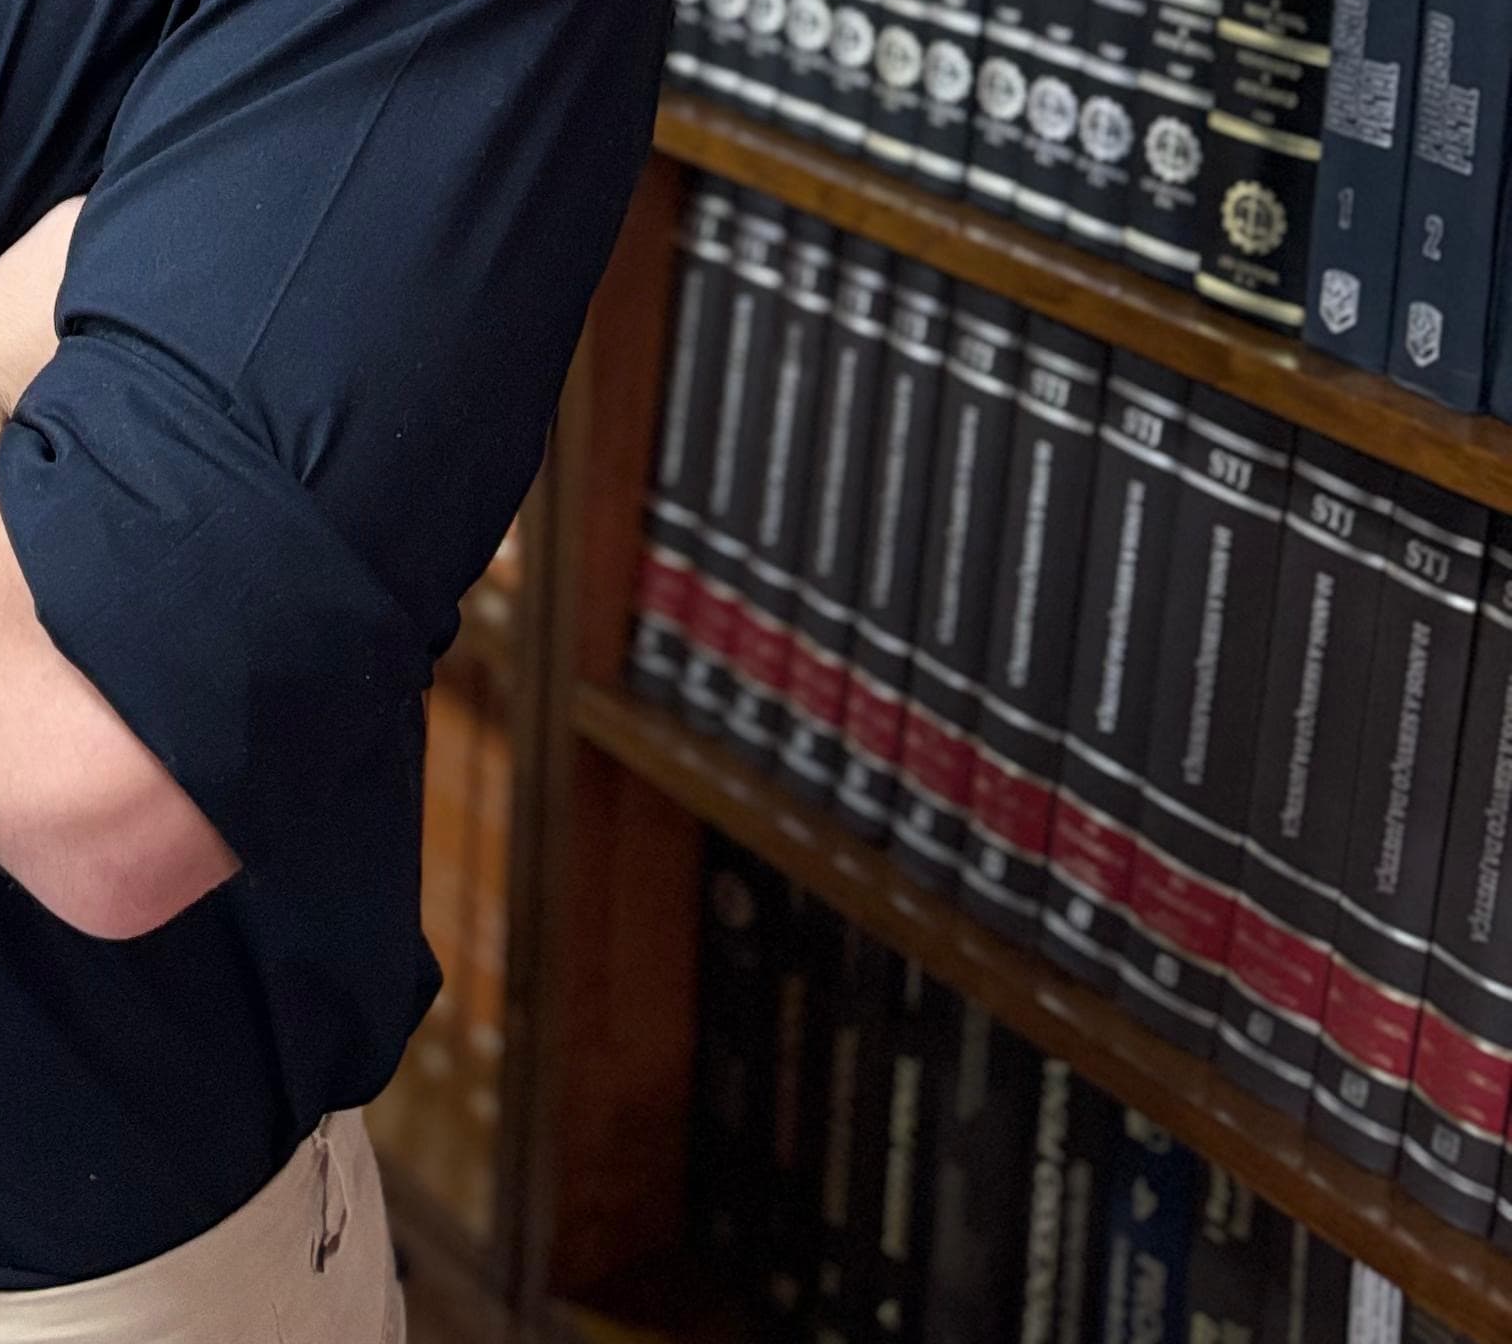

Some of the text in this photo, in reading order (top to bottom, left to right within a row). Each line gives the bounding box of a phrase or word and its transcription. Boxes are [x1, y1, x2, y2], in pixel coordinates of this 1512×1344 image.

[1356, 59, 1400, 149] PENAL
[1413, 10, 1455, 164] PROCESSO
[1438, 83, 1480, 176] PENAL
[1338, 187, 1355, 230] 1
[1421, 214, 1444, 261] 2
[1208, 448, 1253, 492] STJ
[1312, 492, 1356, 540] STJ
[1405, 538, 1451, 584] STJ
[1403, 649, 1427, 698] ANOS
[1388, 713, 1419, 793] SERVIÇO
[1483, 758, 1512, 838] SERVIÇO
[1375, 819, 1405, 895] JUSTIÇA
[1469, 866, 1499, 943] JUSTIÇA
[1021, 1161, 1065, 1344] ROCESSO
